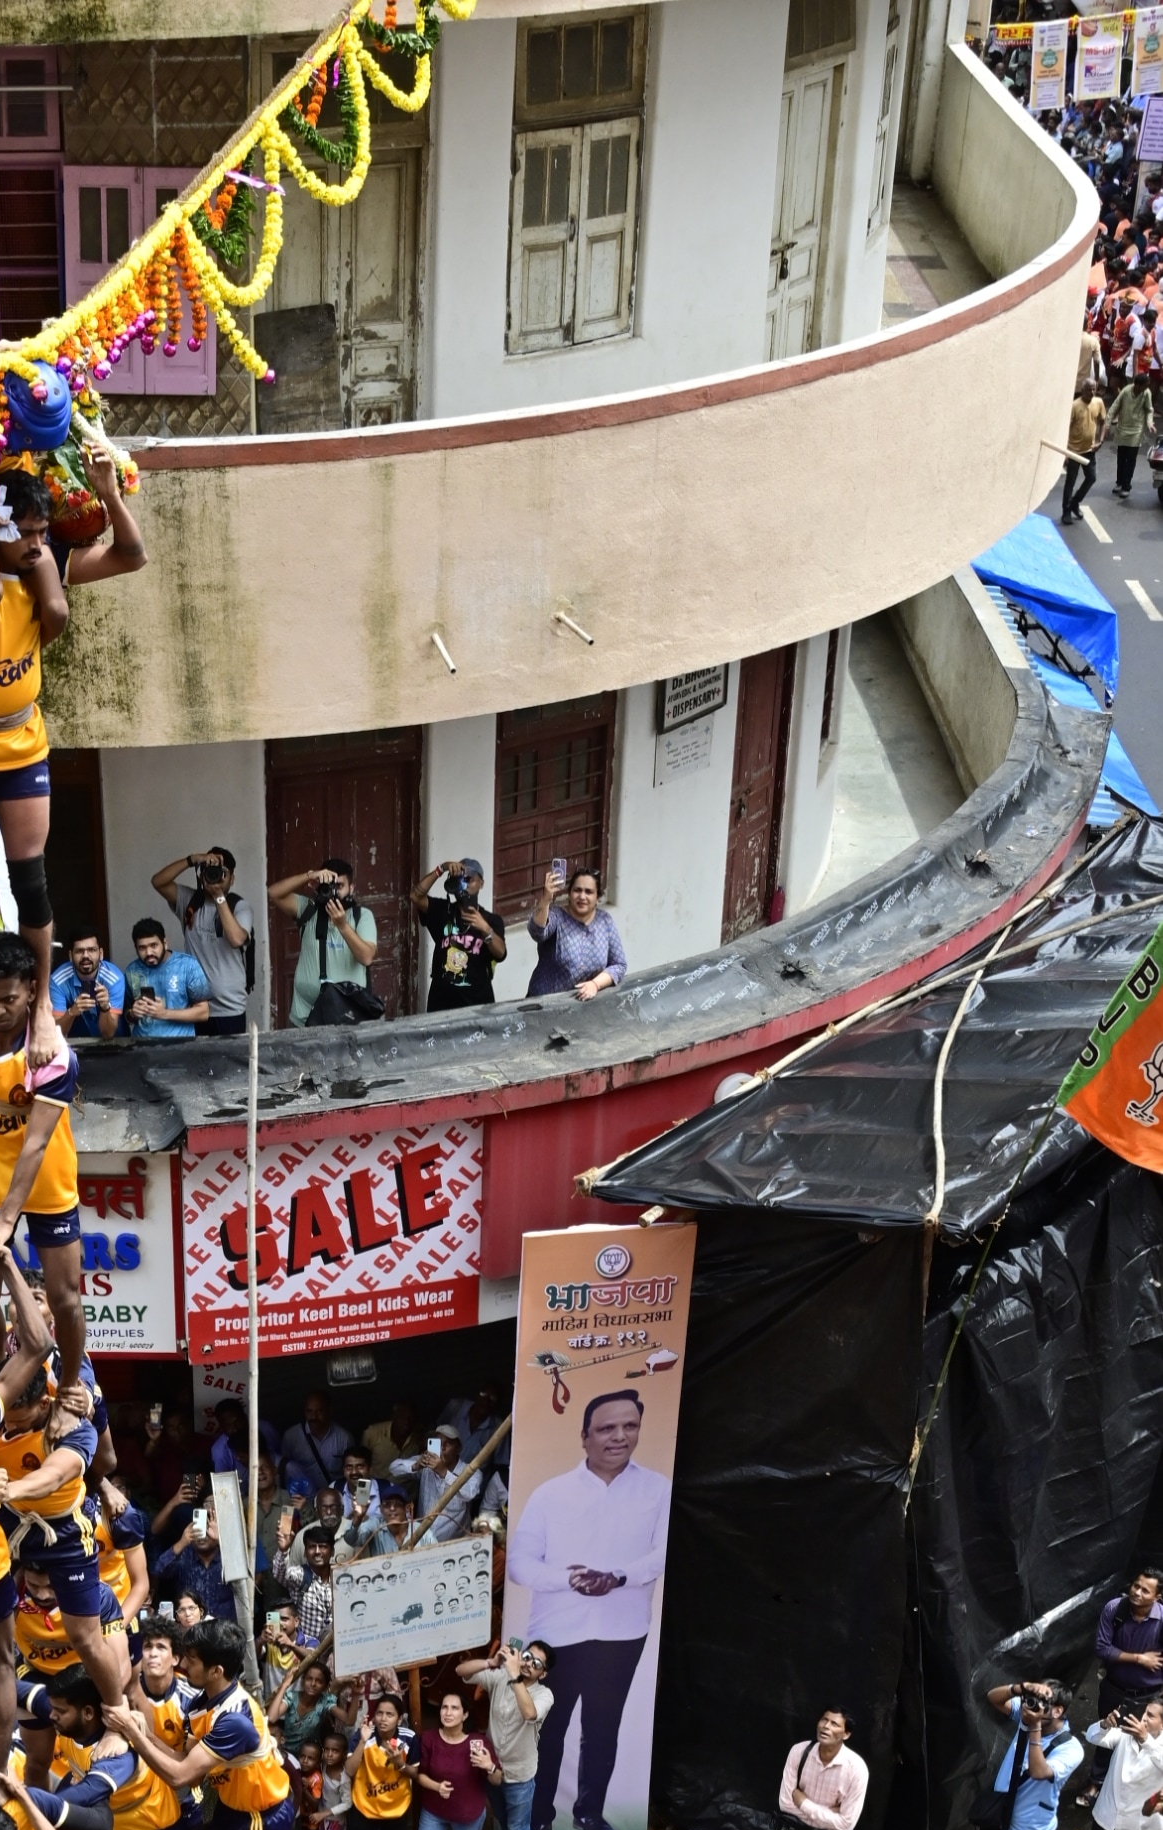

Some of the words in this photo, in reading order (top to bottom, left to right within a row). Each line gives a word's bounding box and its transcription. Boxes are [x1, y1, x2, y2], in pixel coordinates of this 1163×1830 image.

[672, 688, 716, 718] DISPENSARY
[220, 1143, 450, 1291] SALE
[545, 1275, 677, 1311] भाजपा
[299, 1305, 333, 1322] Keel
[338, 1300, 372, 1318] Beel
[377, 1295, 410, 1313] Kids
[413, 1289, 454, 1307] Wear
[542, 1315, 588, 1331] माहिम
[593, 1310, 673, 1328] विधानसभा
[85, 1329, 144, 1337] SUPPLIES
[617, 1330, 646, 1346] १९२
[281, 1341, 306, 1352] GSTIN
[203, 1375, 246, 1394] SALE
